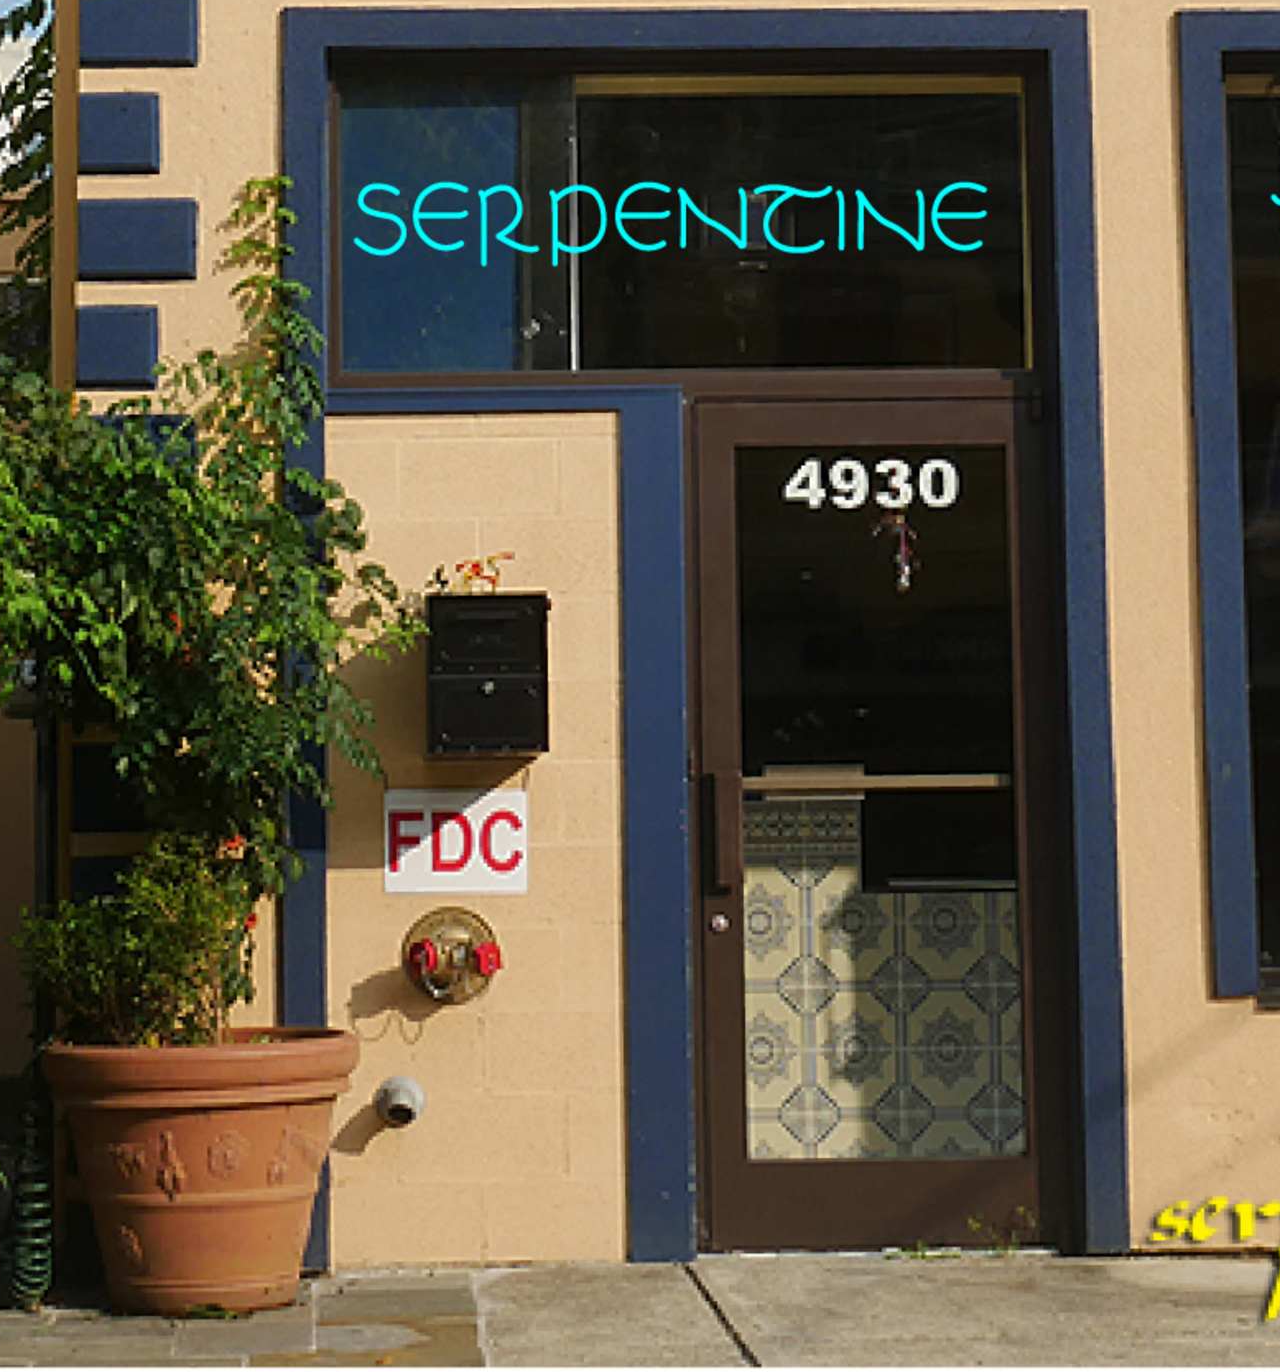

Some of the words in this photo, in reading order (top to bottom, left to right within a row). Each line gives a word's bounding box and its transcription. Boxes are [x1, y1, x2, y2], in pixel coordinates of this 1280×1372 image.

[353, 180, 988, 267] SERPENTINE
[783, 458, 959, 510] 4930
[387, 809, 524, 874] FDC
